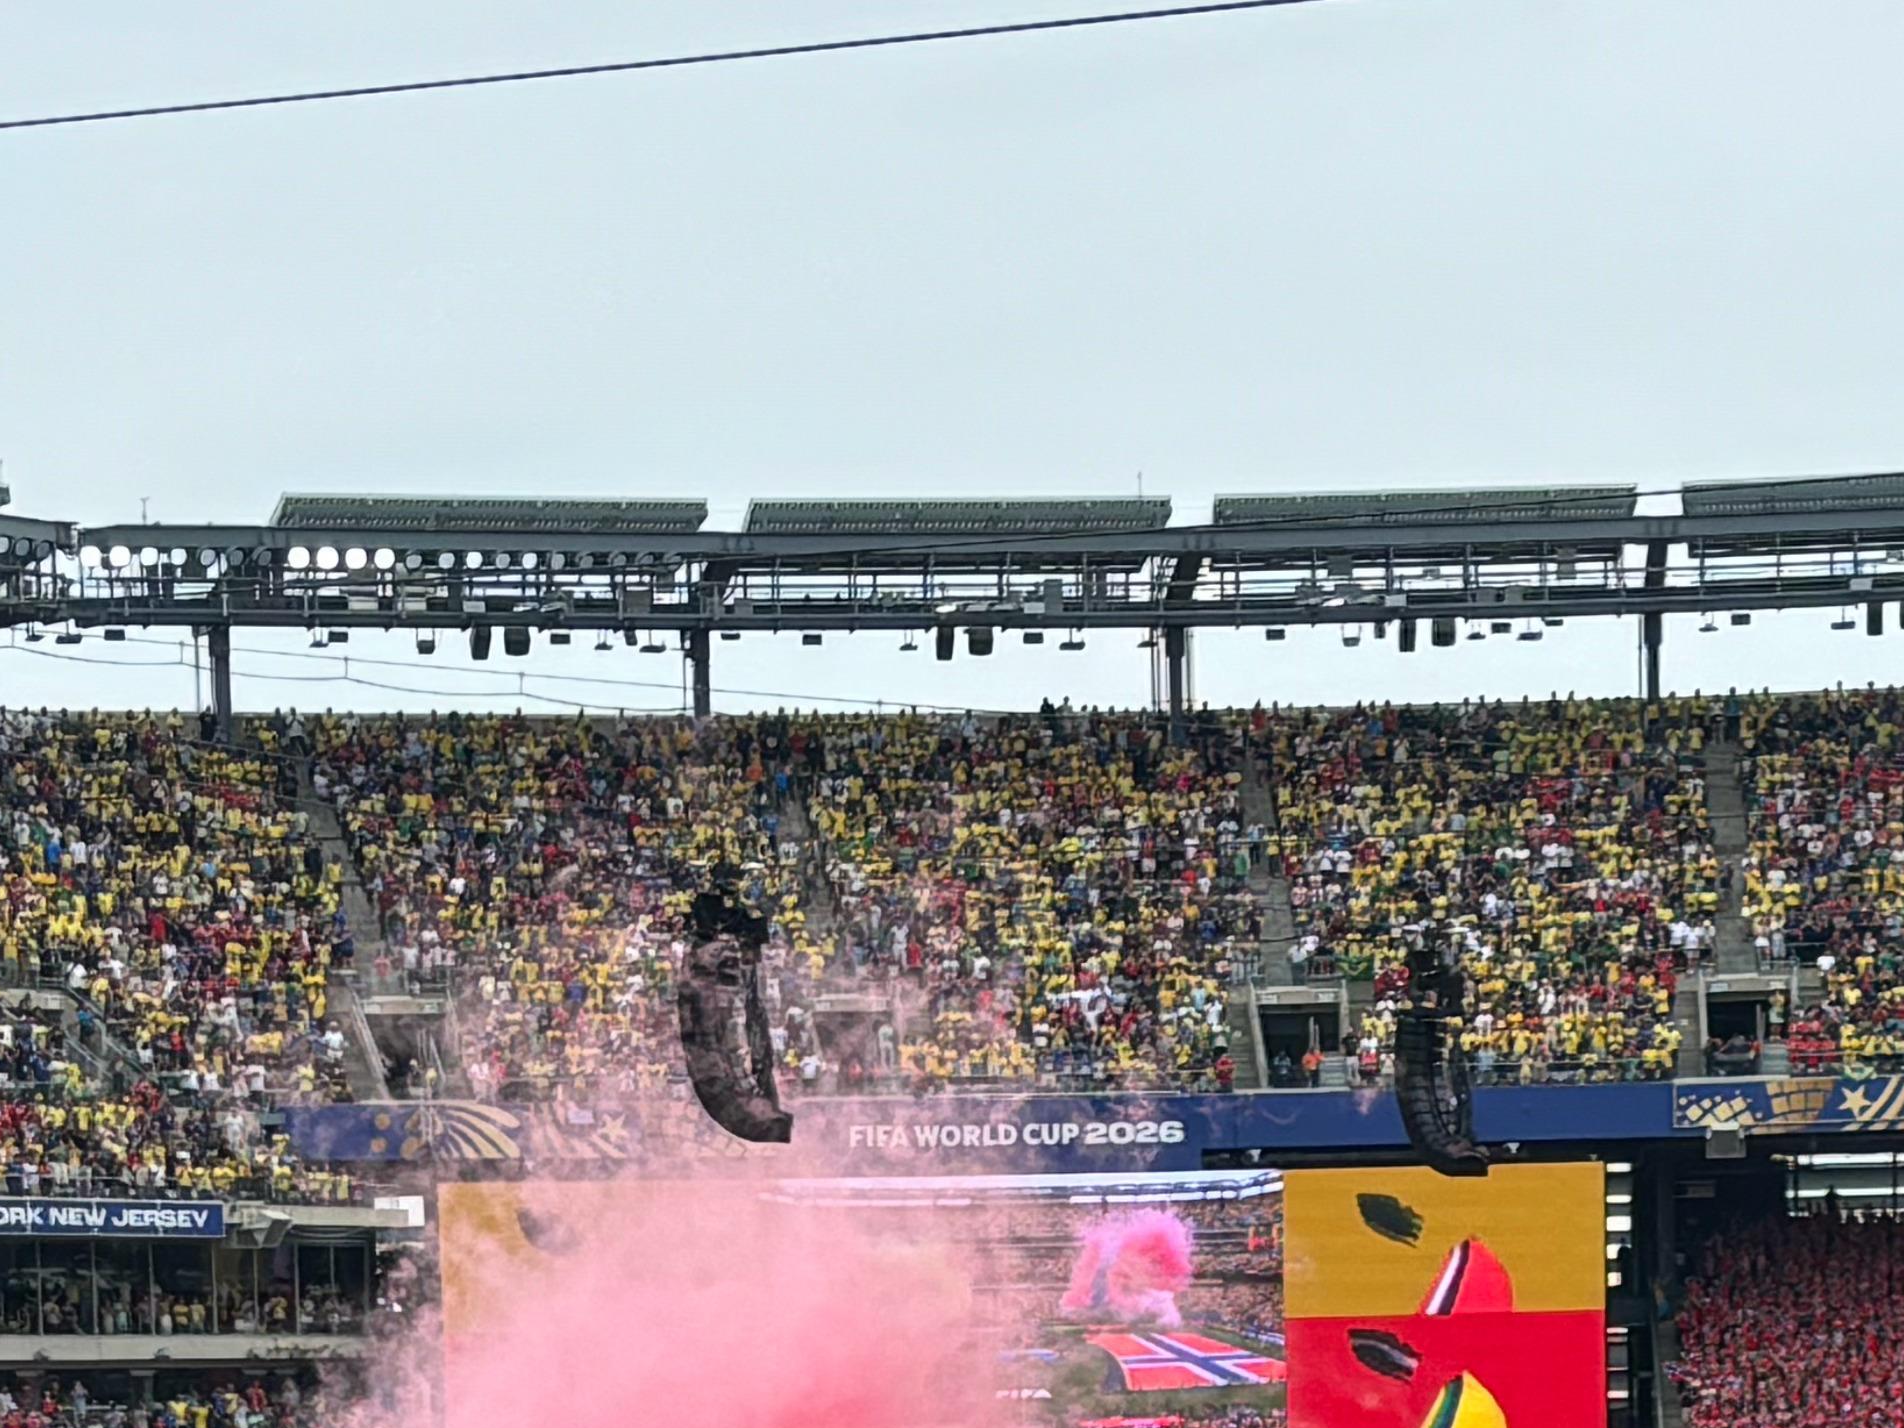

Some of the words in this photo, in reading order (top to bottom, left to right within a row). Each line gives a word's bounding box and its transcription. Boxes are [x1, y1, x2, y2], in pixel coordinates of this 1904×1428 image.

[849, 1124, 909, 1148] FIFA
[914, 1123, 1017, 1148] WORLD
[1022, 1122, 1080, 1146] CUP
[1084, 1120, 1185, 1144] 2026
[49, 1206, 107, 1227] NEW
[111, 1208, 209, 1229] JERSEY
